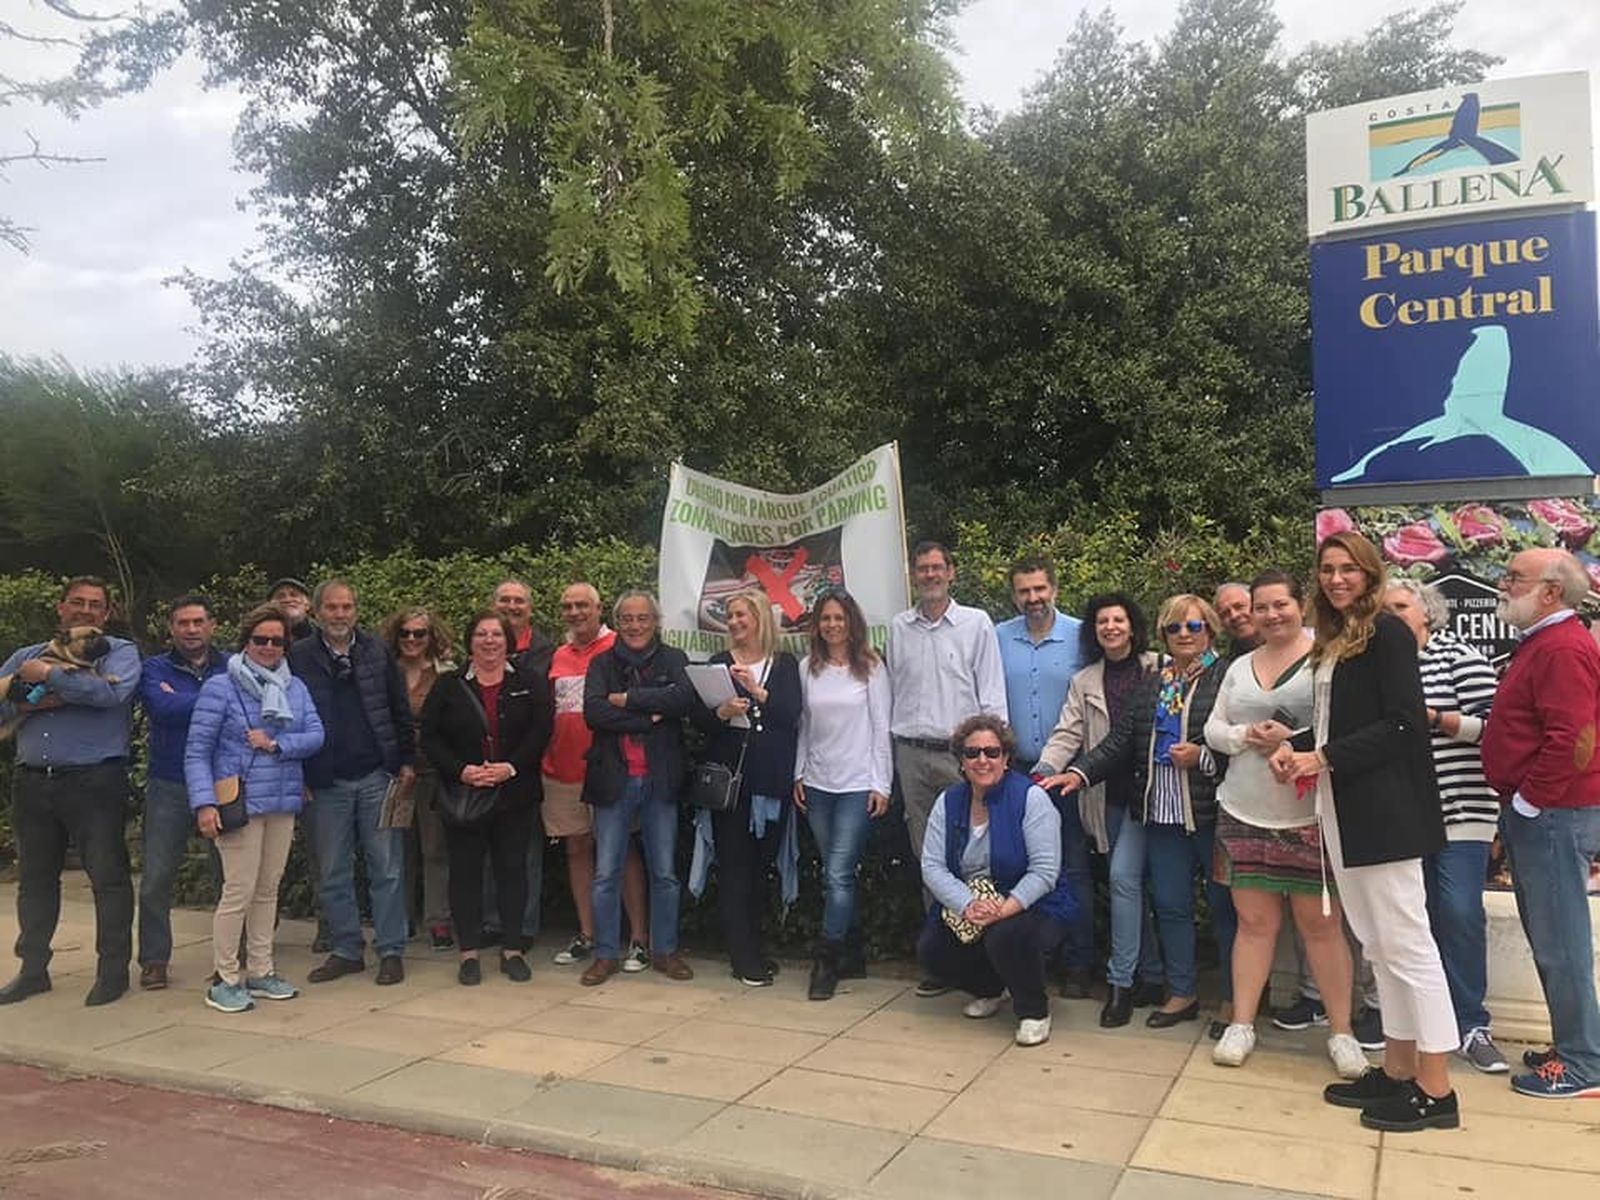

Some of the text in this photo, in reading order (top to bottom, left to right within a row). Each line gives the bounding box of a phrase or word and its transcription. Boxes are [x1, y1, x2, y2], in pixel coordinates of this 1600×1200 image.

[1369, 100, 1451, 121] COSTA
[1333, 154, 1572, 223] BALLENA
[1362, 235, 1549, 280] Parque
[1359, 276, 1556, 329] Central
[749, 497, 806, 522] PARQUE
[777, 516, 814, 543] POR
[816, 484, 887, 528] PARKING
